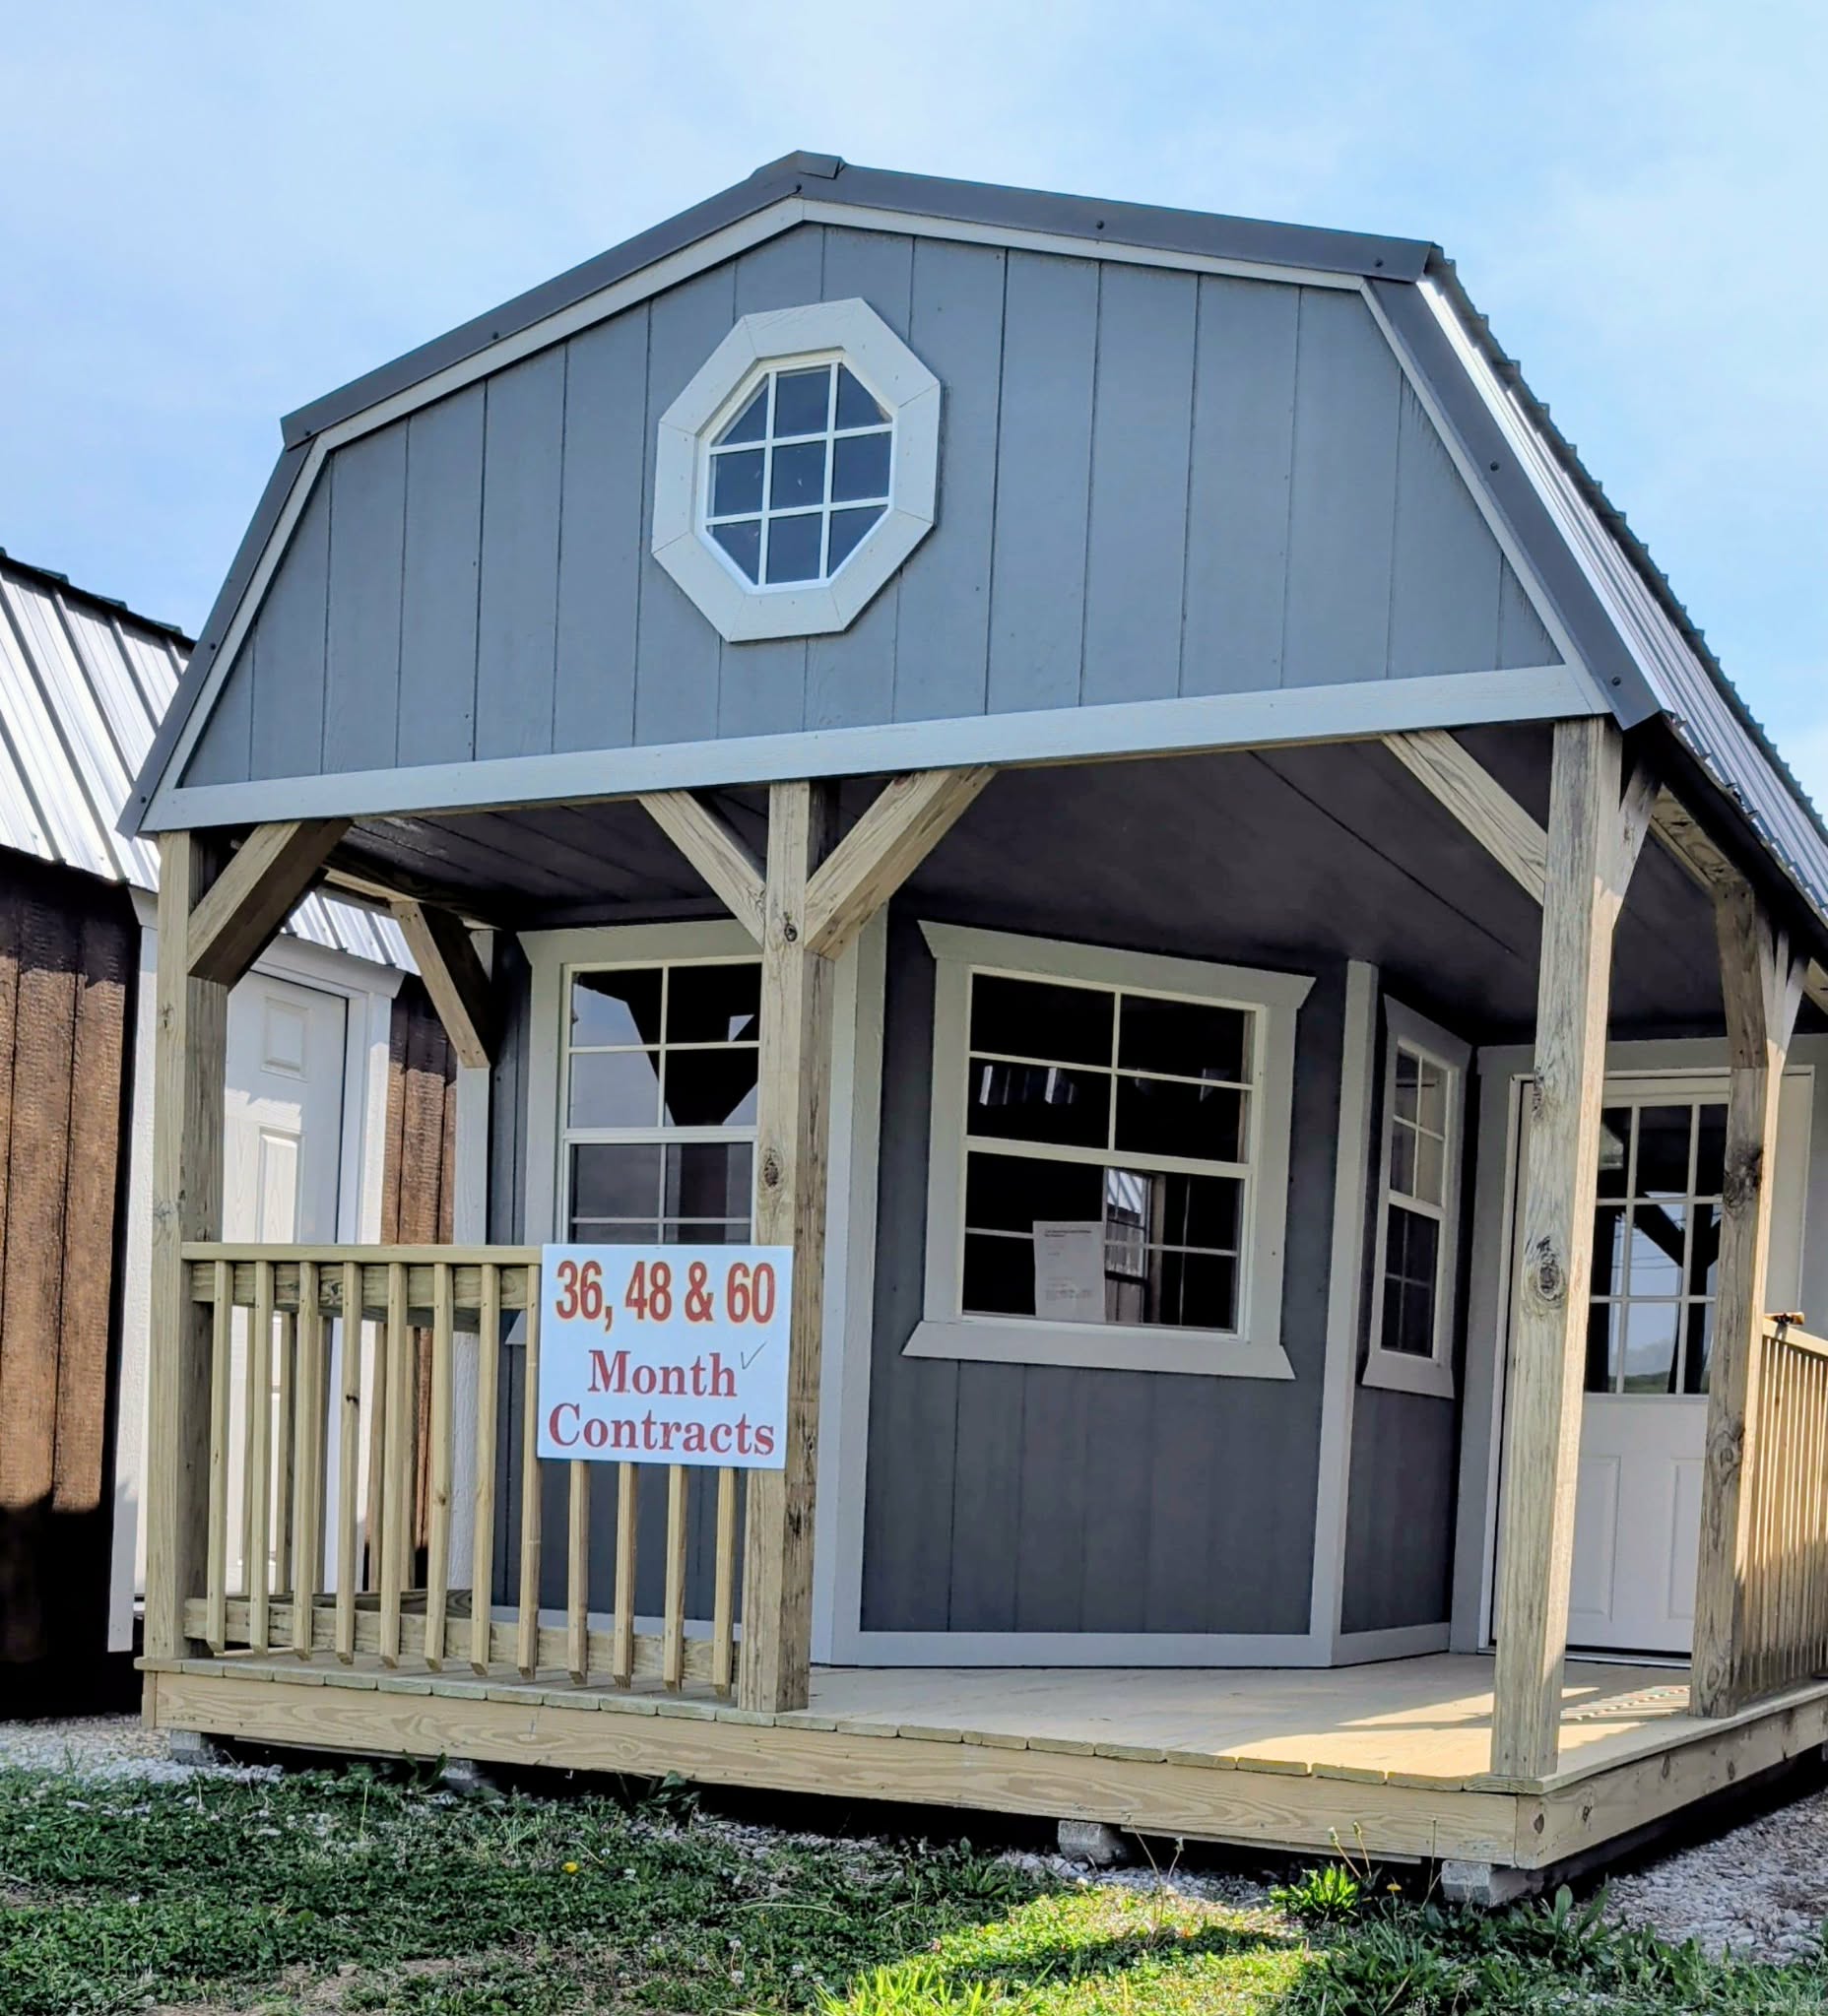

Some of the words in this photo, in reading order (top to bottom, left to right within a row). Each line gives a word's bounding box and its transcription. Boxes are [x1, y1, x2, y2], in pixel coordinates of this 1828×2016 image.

[555, 1261, 613, 1333] 36,
[624, 1261, 673, 1323] 48
[684, 1261, 715, 1323] &
[726, 1262, 776, 1324] 60
[588, 1349, 737, 1398] Month
[549, 1402, 775, 1456] Contracts
